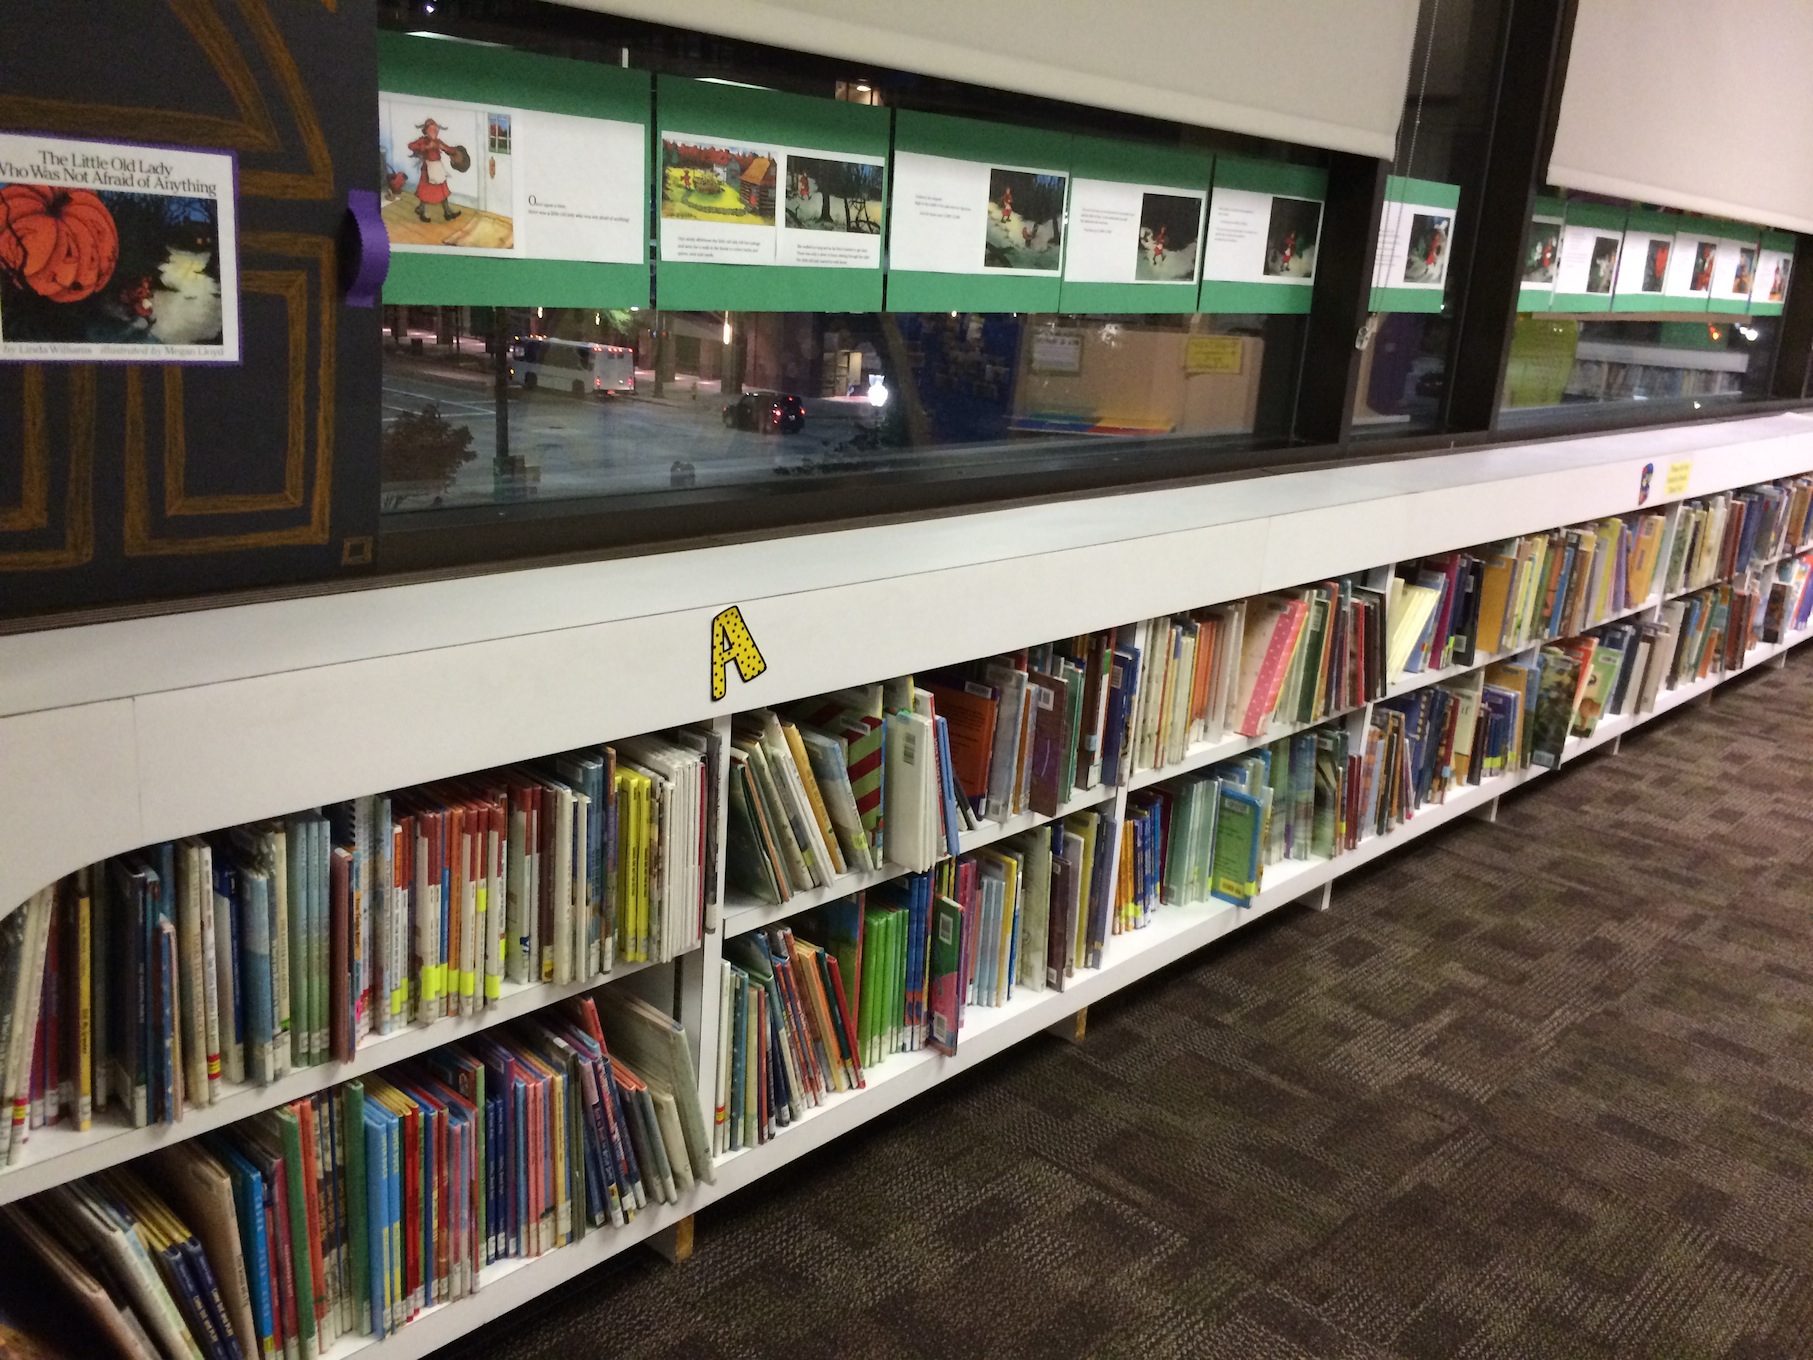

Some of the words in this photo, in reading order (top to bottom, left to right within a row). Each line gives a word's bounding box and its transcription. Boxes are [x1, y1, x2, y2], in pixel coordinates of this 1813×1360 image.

[30, 164, 60, 181] Was
[63, 168, 88, 183] Not
[93, 171, 134, 188] Afraid
[137, 176, 150, 188] of
[154, 176, 217, 197] Anything
[38, 150, 68, 166] The
[71, 153, 108, 169] Little
[111, 157, 136, 173] Old
[139, 160, 173, 179] Lady
[710, 605, 767, 702] A
